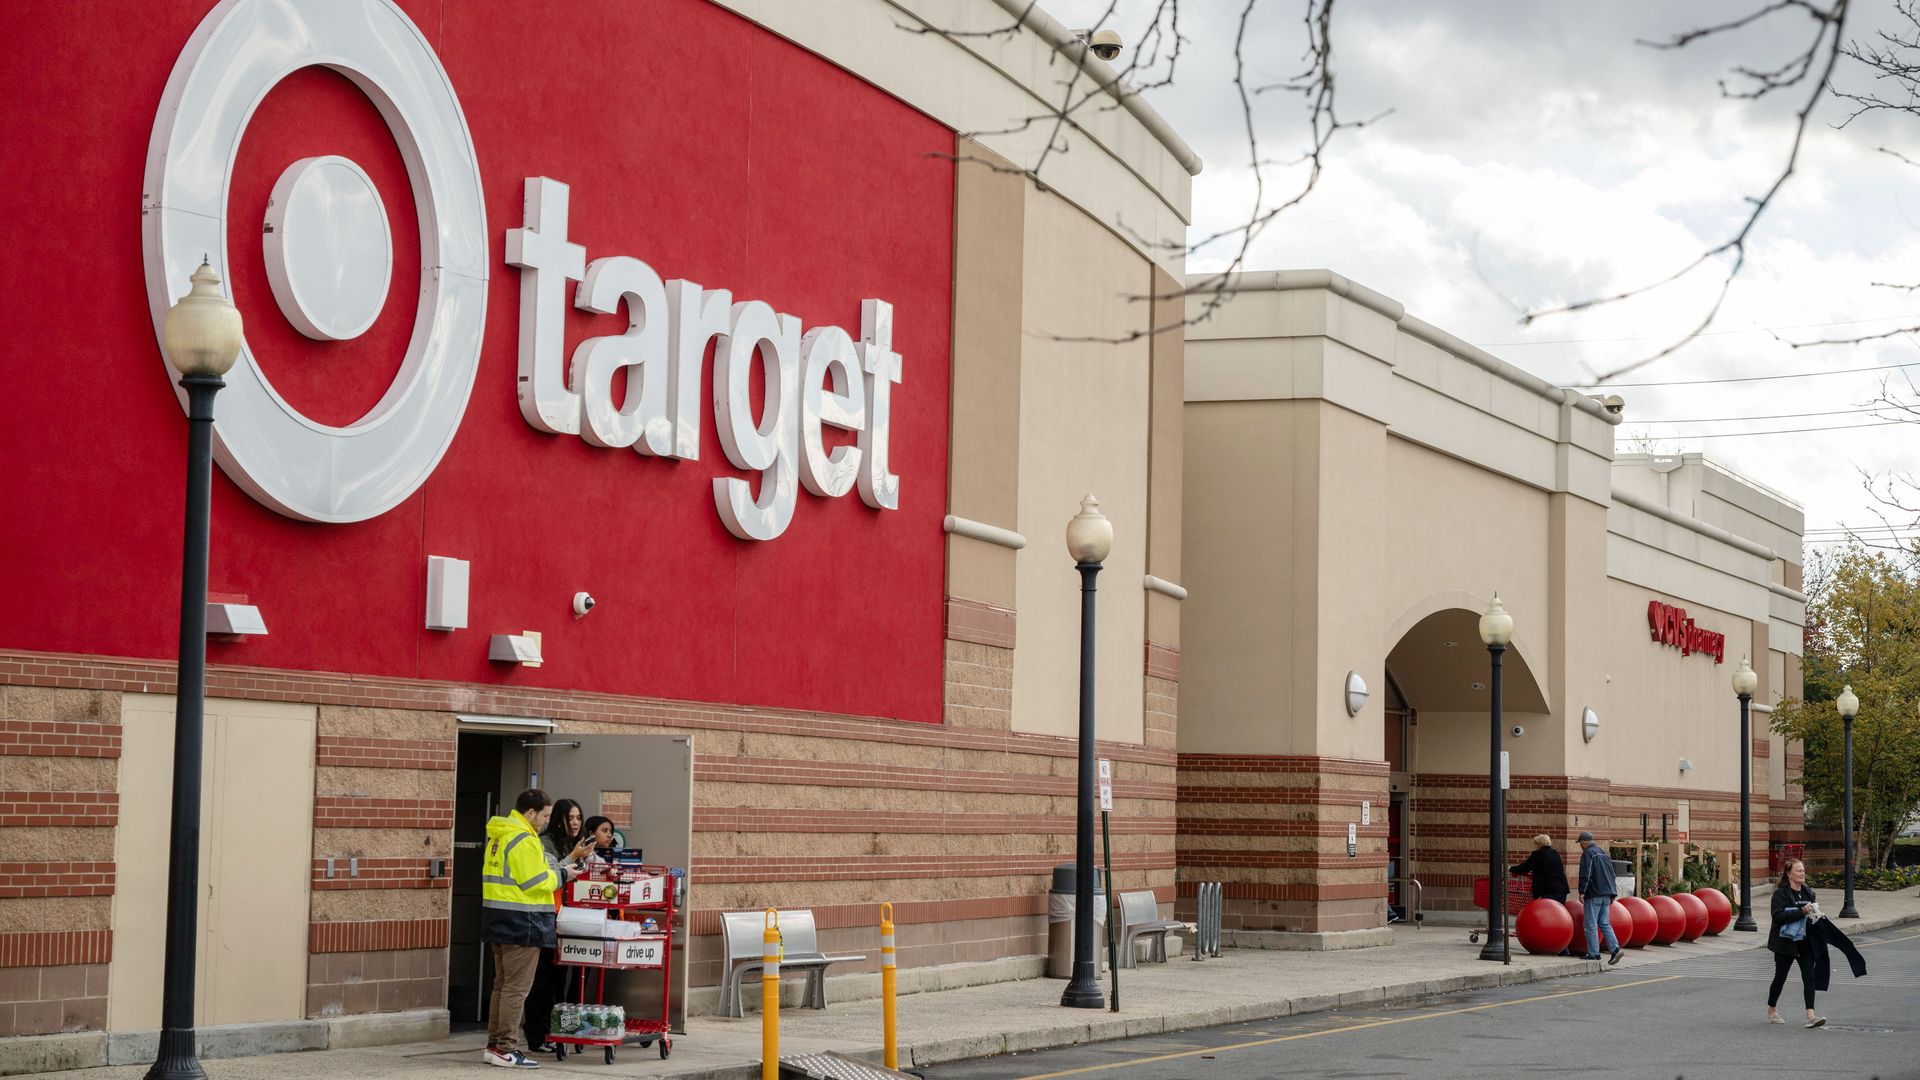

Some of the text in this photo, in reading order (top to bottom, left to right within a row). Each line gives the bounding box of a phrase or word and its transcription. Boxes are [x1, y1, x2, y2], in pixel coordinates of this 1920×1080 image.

[505, 176, 902, 541] target
[1662, 604, 1687, 649] CVS
[563, 945, 602, 957] drive up
[626, 946, 654, 960] drive up
